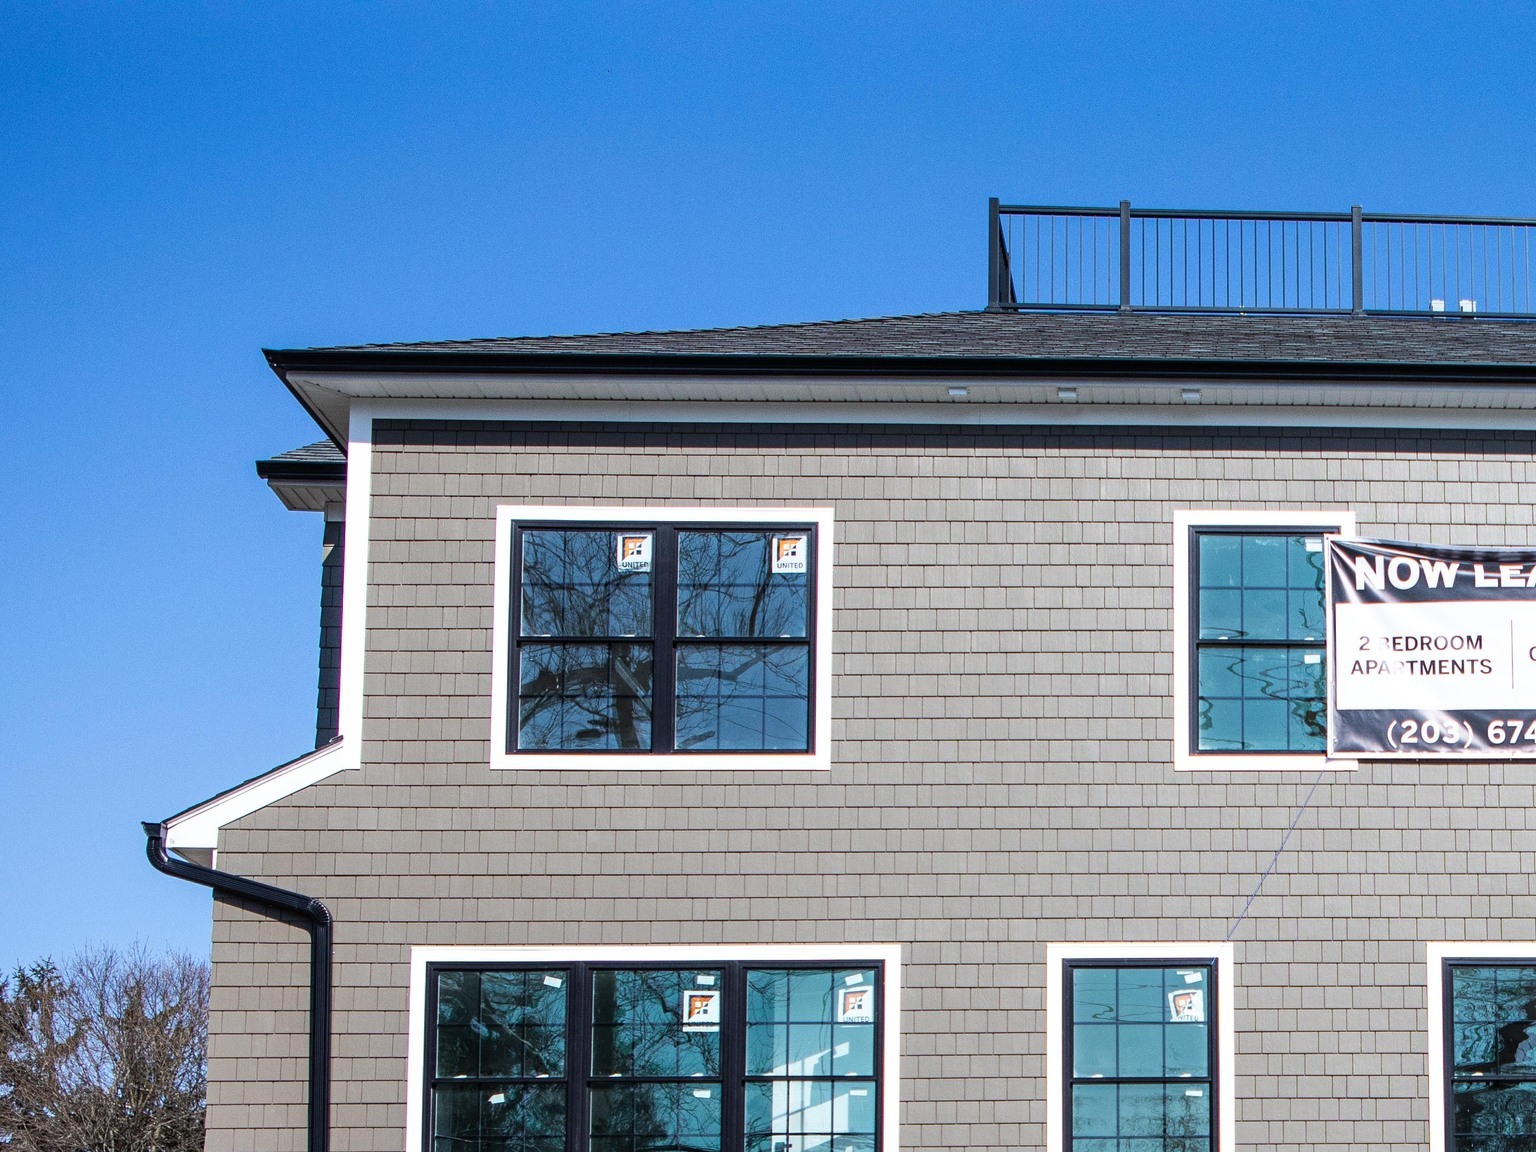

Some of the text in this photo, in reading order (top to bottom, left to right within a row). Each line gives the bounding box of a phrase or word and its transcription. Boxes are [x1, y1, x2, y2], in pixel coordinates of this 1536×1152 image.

[1355, 555, 1460, 591] NOW
[1359, 634, 1483, 651] 2 BEDROOM
[1350, 659, 1493, 675] APARTMENTS
[1387, 719, 1474, 749] (203)
